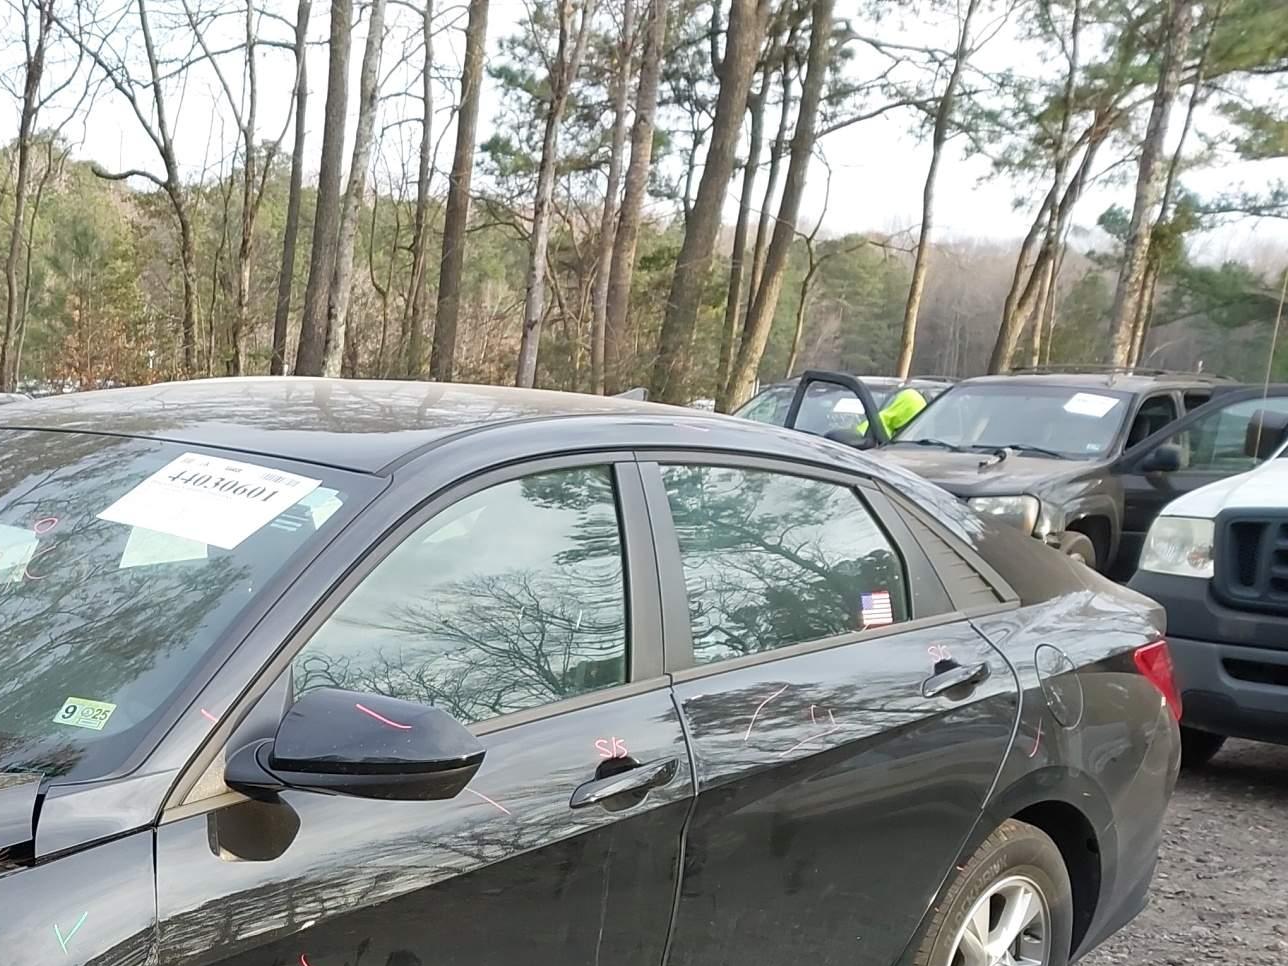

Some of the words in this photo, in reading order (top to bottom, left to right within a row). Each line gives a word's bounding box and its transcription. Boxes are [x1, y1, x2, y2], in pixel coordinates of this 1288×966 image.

[168, 470, 280, 502] 44030601
[62, 704, 78, 720] 9
[91, 707, 111, 721] 25
[942, 853, 1009, 948] ACKHAWK
